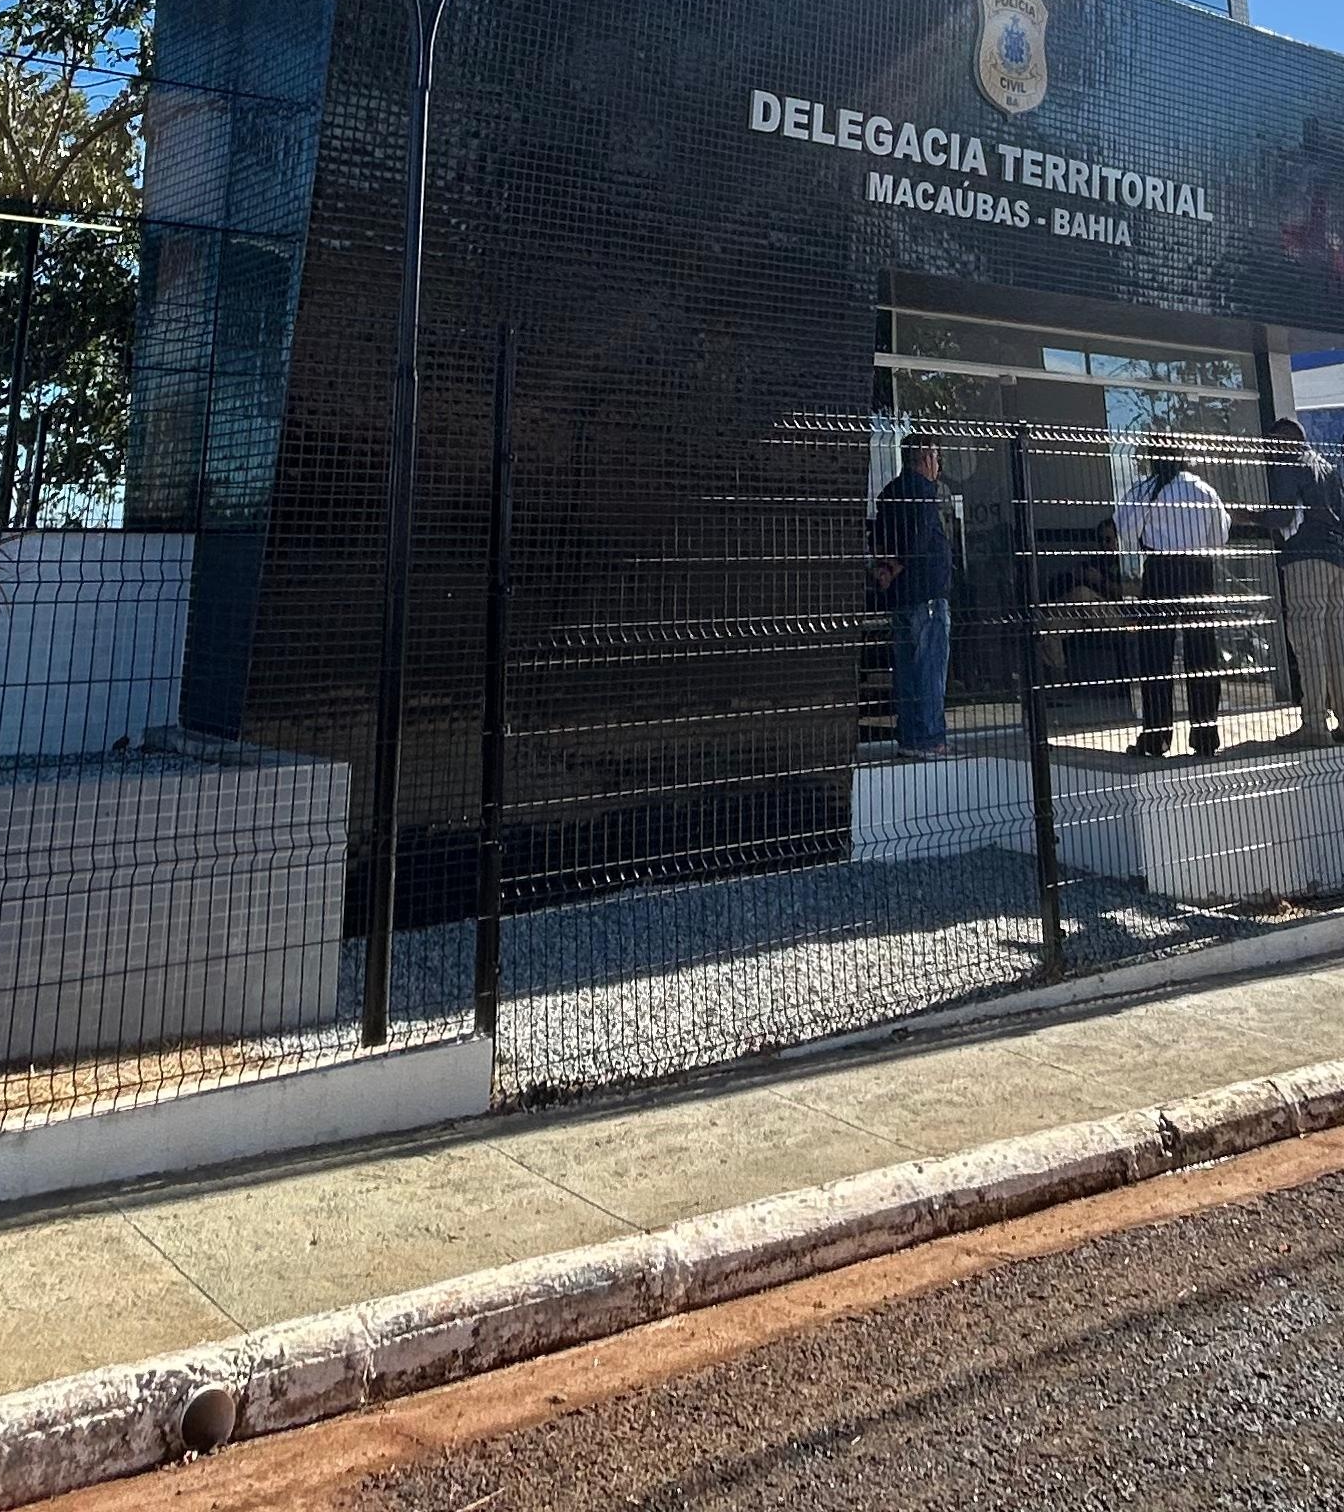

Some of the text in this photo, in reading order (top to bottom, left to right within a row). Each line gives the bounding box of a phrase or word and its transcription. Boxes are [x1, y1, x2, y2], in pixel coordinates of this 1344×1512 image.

[999, 77, 1027, 93] CIVIL
[749, 89, 1214, 222] DELEGACIA TERRITORIAL
[866, 172, 1031, 228] MACAÚBAS
[1052, 207, 1132, 247] BAHIA
